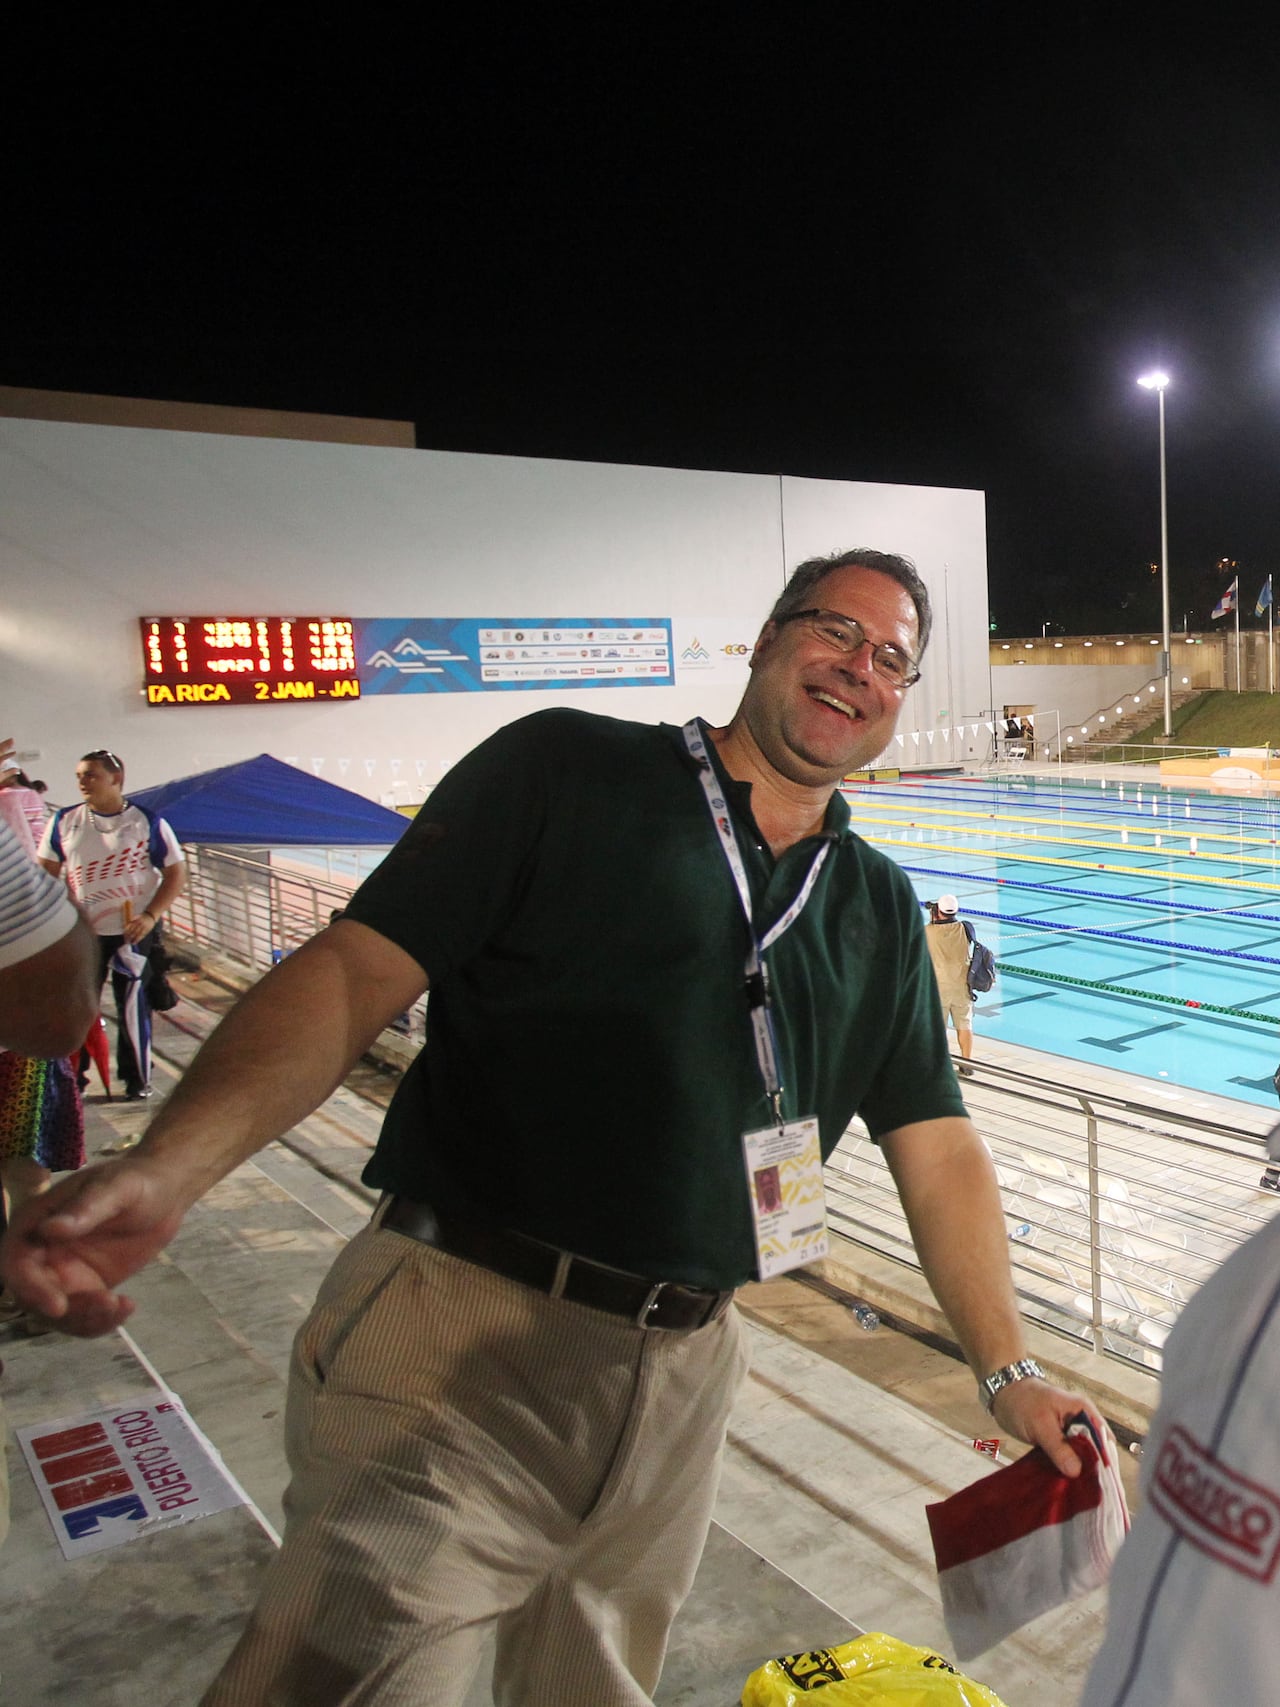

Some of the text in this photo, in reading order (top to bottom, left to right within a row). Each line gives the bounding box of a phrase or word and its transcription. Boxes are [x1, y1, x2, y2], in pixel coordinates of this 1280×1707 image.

[176, 683, 231, 702] RICA
[255, 682, 270, 700] 2
[272, 681, 315, 699] JAM
[112, 1409, 199, 1511] PUERTO RICO
